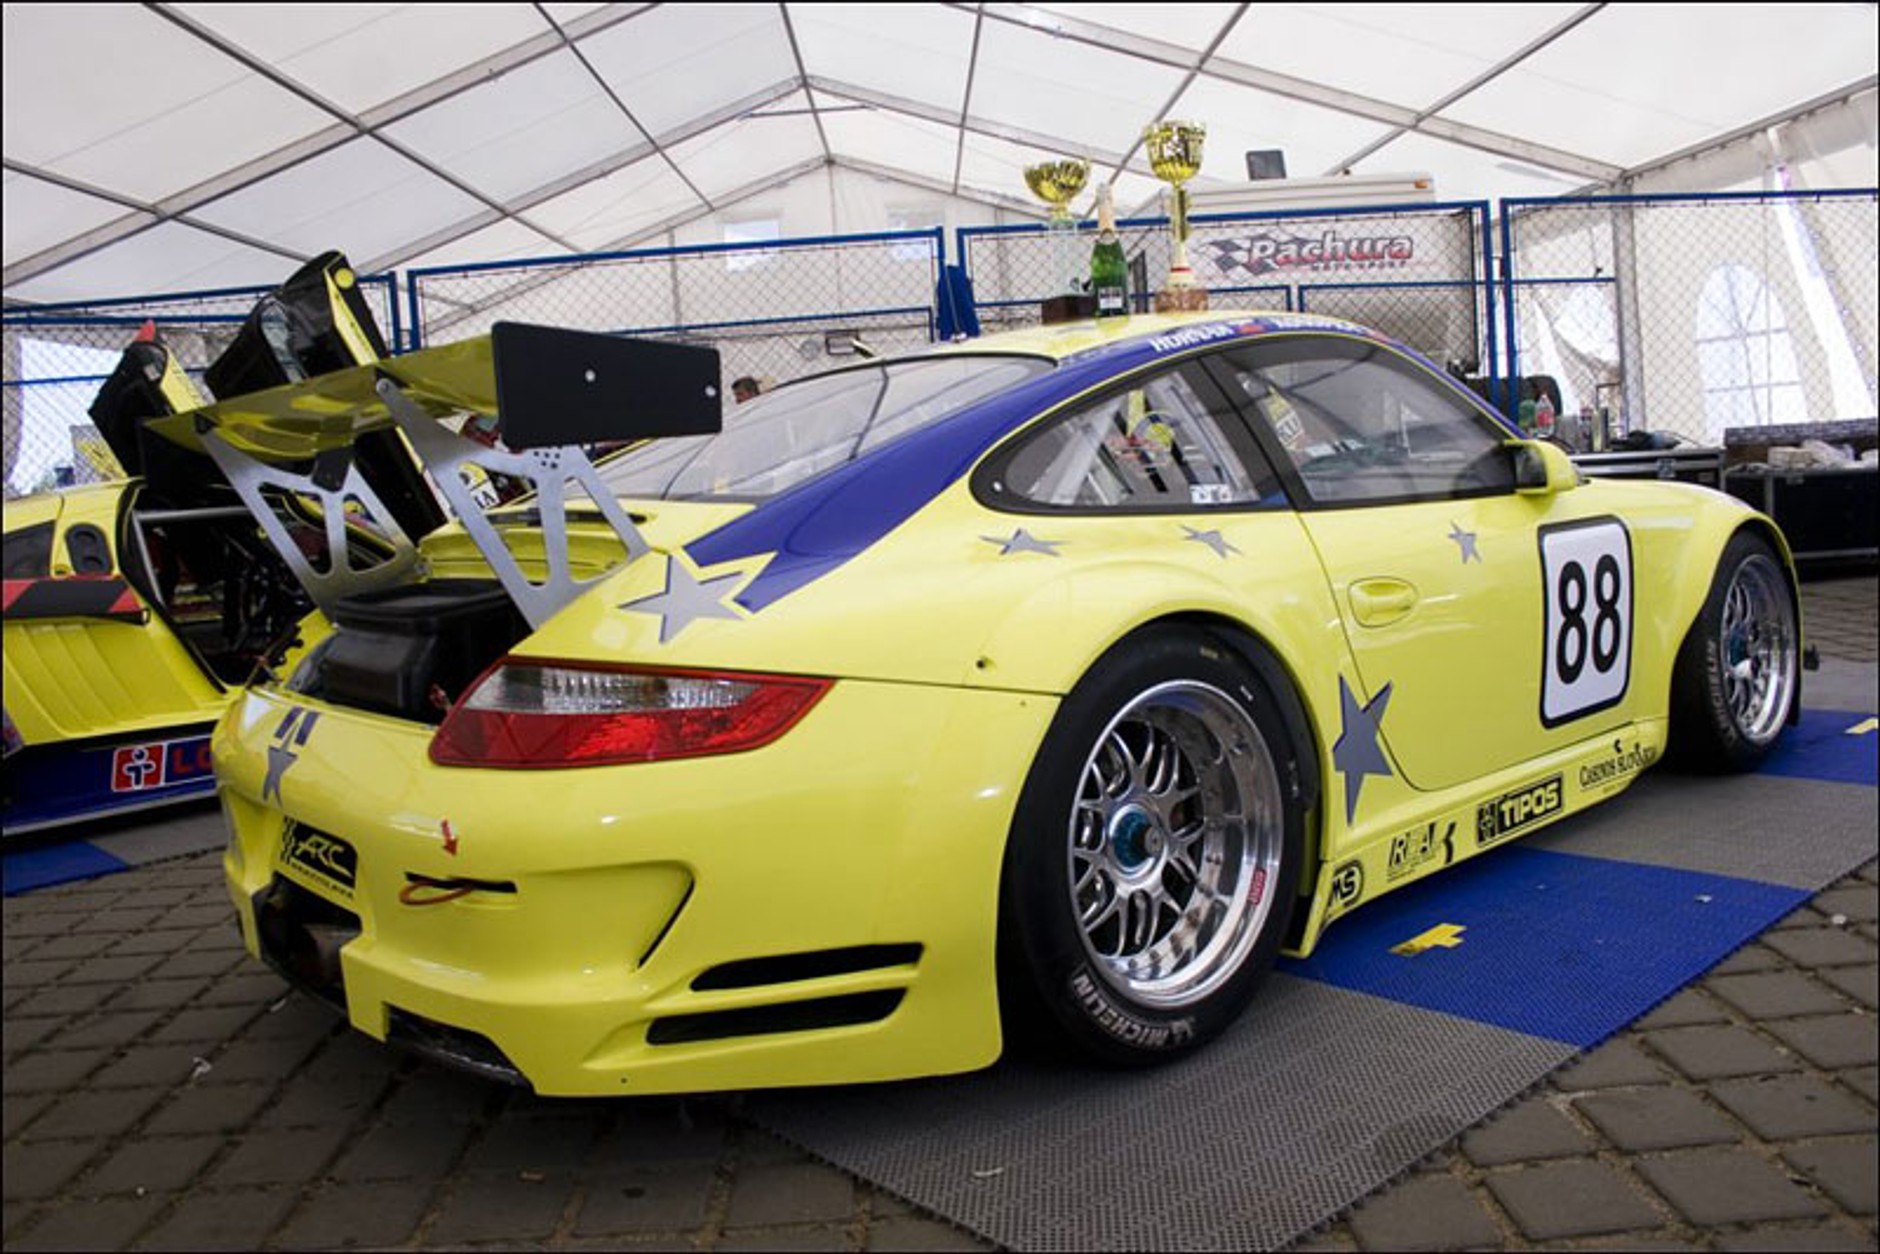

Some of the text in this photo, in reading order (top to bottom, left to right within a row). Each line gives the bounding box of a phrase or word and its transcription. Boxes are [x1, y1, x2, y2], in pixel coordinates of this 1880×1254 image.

[1248, 230, 1413, 267] Pachura
[1556, 554, 1621, 685] 88
[1501, 781, 1559, 828] TIPOS
[1073, 974, 1171, 1047] MICHELIN
